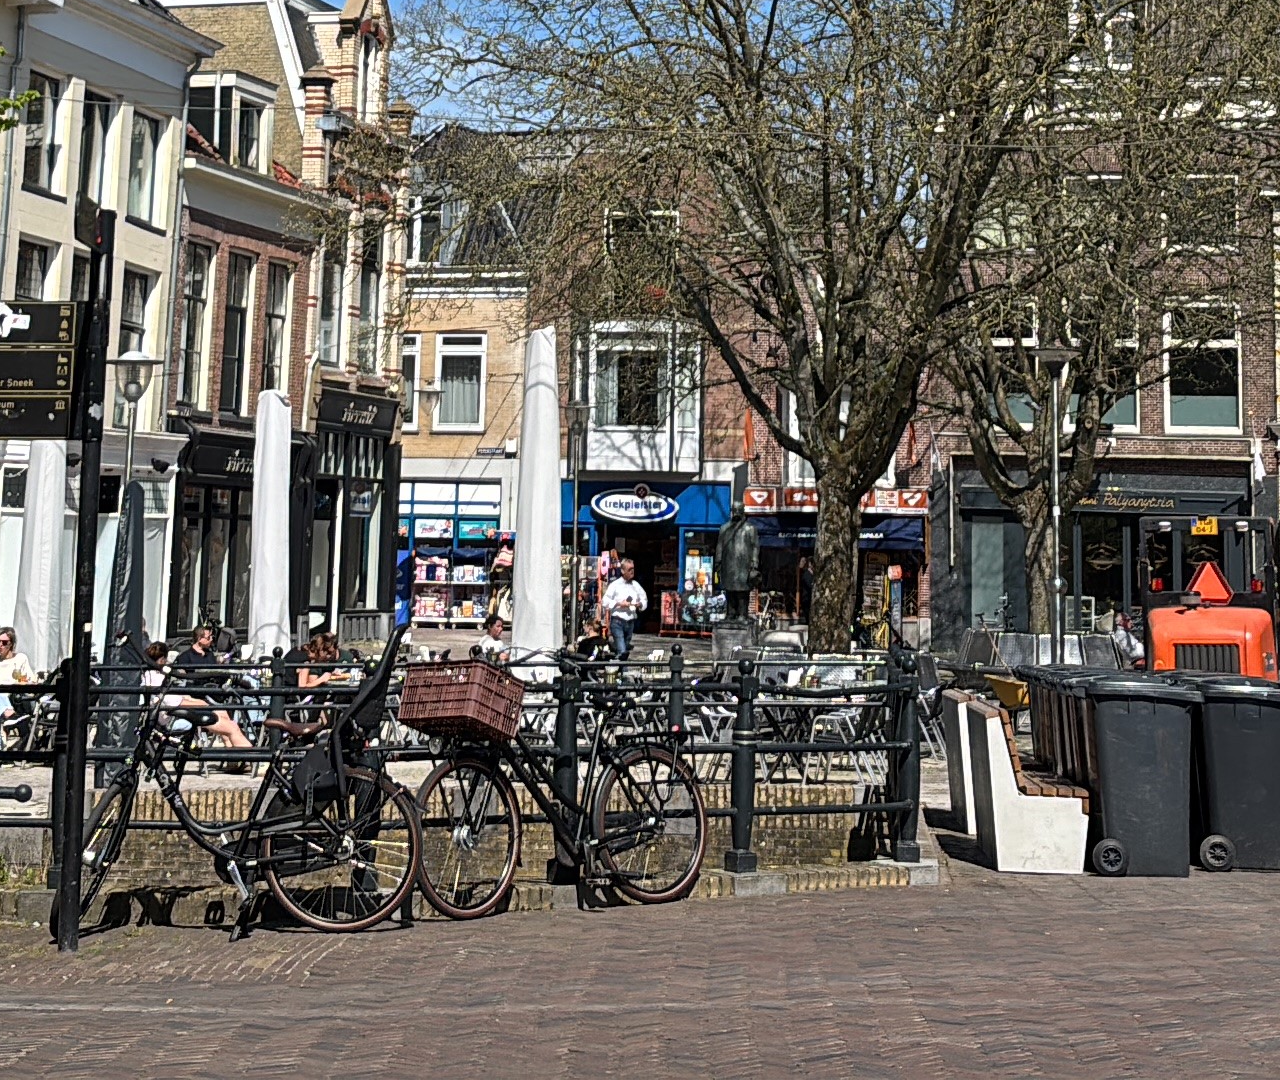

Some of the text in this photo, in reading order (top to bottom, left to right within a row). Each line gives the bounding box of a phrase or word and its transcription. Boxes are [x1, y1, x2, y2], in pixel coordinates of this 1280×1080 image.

[7, 378, 34, 388] Sneek
[604, 500, 663, 511] trekpleister
[1102, 492, 1175, 512] Palyanytsia
